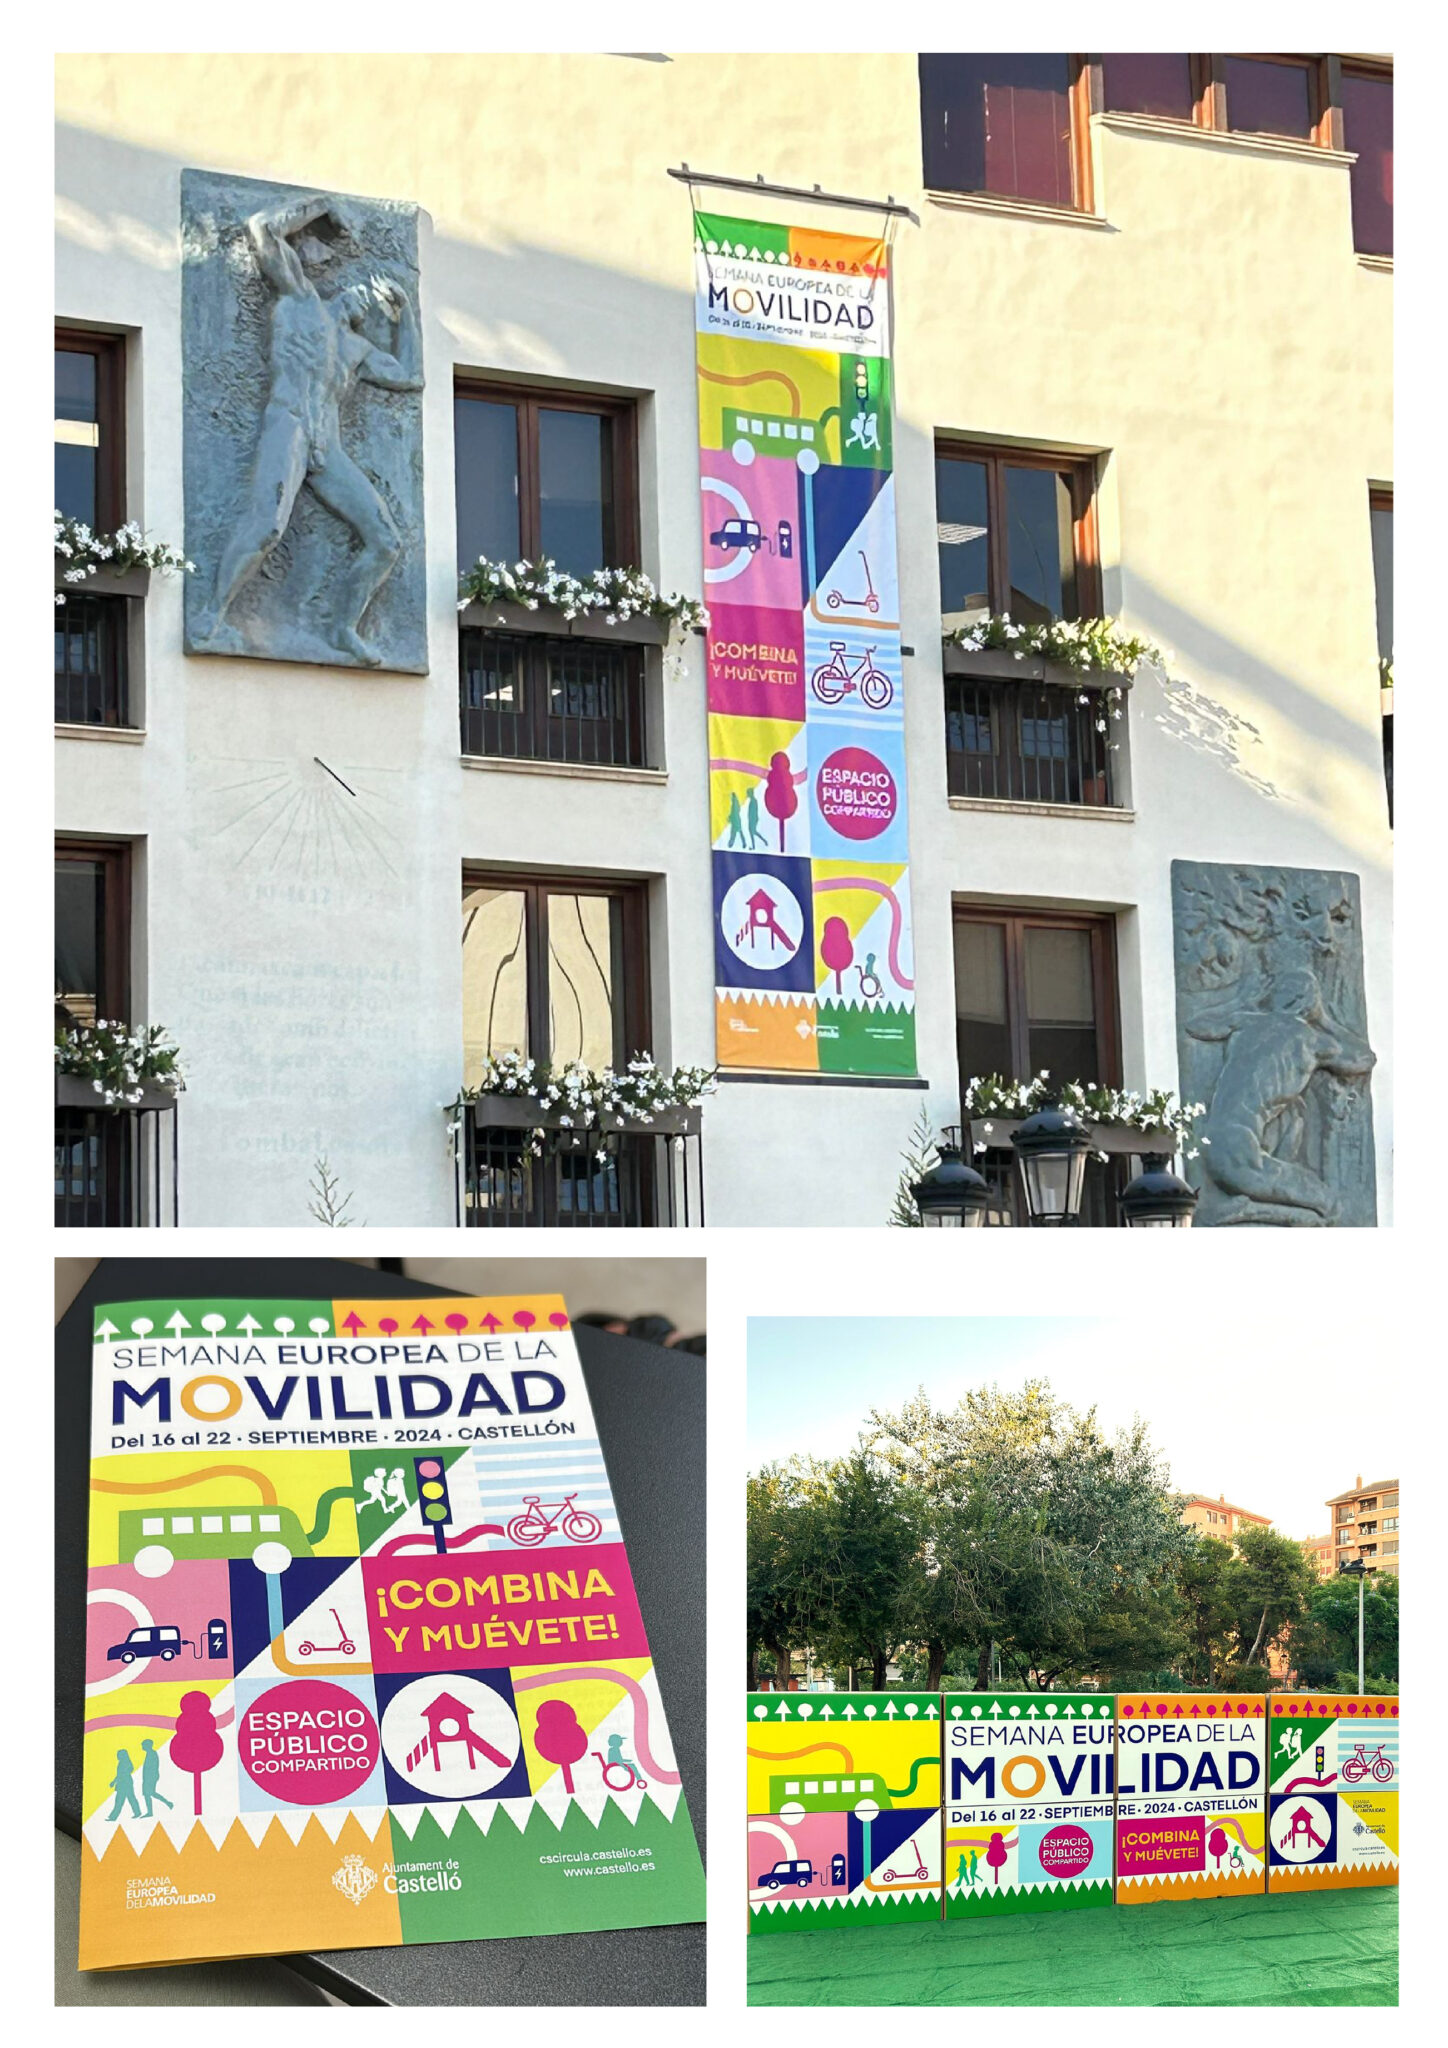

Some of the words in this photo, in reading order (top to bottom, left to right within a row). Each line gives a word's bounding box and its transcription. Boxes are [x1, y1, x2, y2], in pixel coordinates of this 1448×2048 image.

[708, 282, 875, 330] MOVILIDAD
[822, 768, 890, 788] ESPACIO
[113, 1345, 266, 1369] SEMANA
[278, 1344, 448, 1365] EUROPEA
[458, 1342, 504, 1362] DE
[515, 1339, 557, 1360] LA
[112, 1370, 567, 1425] MOVILIDAD
[112, 1434, 144, 1448] Del
[152, 1434, 175, 1446] 16
[182, 1432, 200, 1445] al
[207, 1432, 231, 1445] 22
[248, 1430, 378, 1444] SEPTIEMBRE
[394, 1429, 441, 1442] 2024
[458, 1420, 575, 1440] CASTELLÓN
[377, 1569, 615, 1617] ¡COMBINA
[384, 1627, 410, 1653] Y
[422, 1614, 620, 1651] MUÉVETE!
[248, 1709, 365, 1732] ESPACIO
[250, 1730, 368, 1757] PÚBLICO
[951, 1725, 1064, 1747] SEMANA
[1073, 1724, 1192, 1744] EUROPEA
[1197, 1724, 1226, 1742] DE
[1230, 1723, 1255, 1742] LA
[251, 1755, 370, 1775] COMPARTIDO
[951, 1750, 1260, 1800] MOVILIDAD
[952, 1811, 976, 1823] Del
[980, 1810, 997, 1822] 16
[1002, 1809, 1015, 1820] al
[1020, 1808, 1036, 1820] 22
[1044, 1804, 1136, 1819] SEPTIEMBRE
[1144, 1802, 1175, 1814] 2024
[1184, 1796, 1258, 1812] CASTELLÓN
[1043, 1837, 1089, 1848] ESPACIO
[1122, 1829, 1200, 1848] ¡COMBINA
[540, 1848, 652, 1864] cscircula.castello.es
[1042, 1846, 1089, 1859] PÚBLICO
[1043, 1857, 1089, 1866] COMPARTIDO
[1123, 1852, 1132, 1862] Y
[1135, 1846, 1199, 1861] MUÉVETE!
[382, 1861, 443, 1875] Ajuntament
[446, 1858, 460, 1870] de
[563, 1862, 656, 1877] www.castello.es
[126, 1876, 171, 1889] SEMANA
[126, 1886, 178, 1899] EUROPEA
[384, 1871, 462, 1894] Castelló
